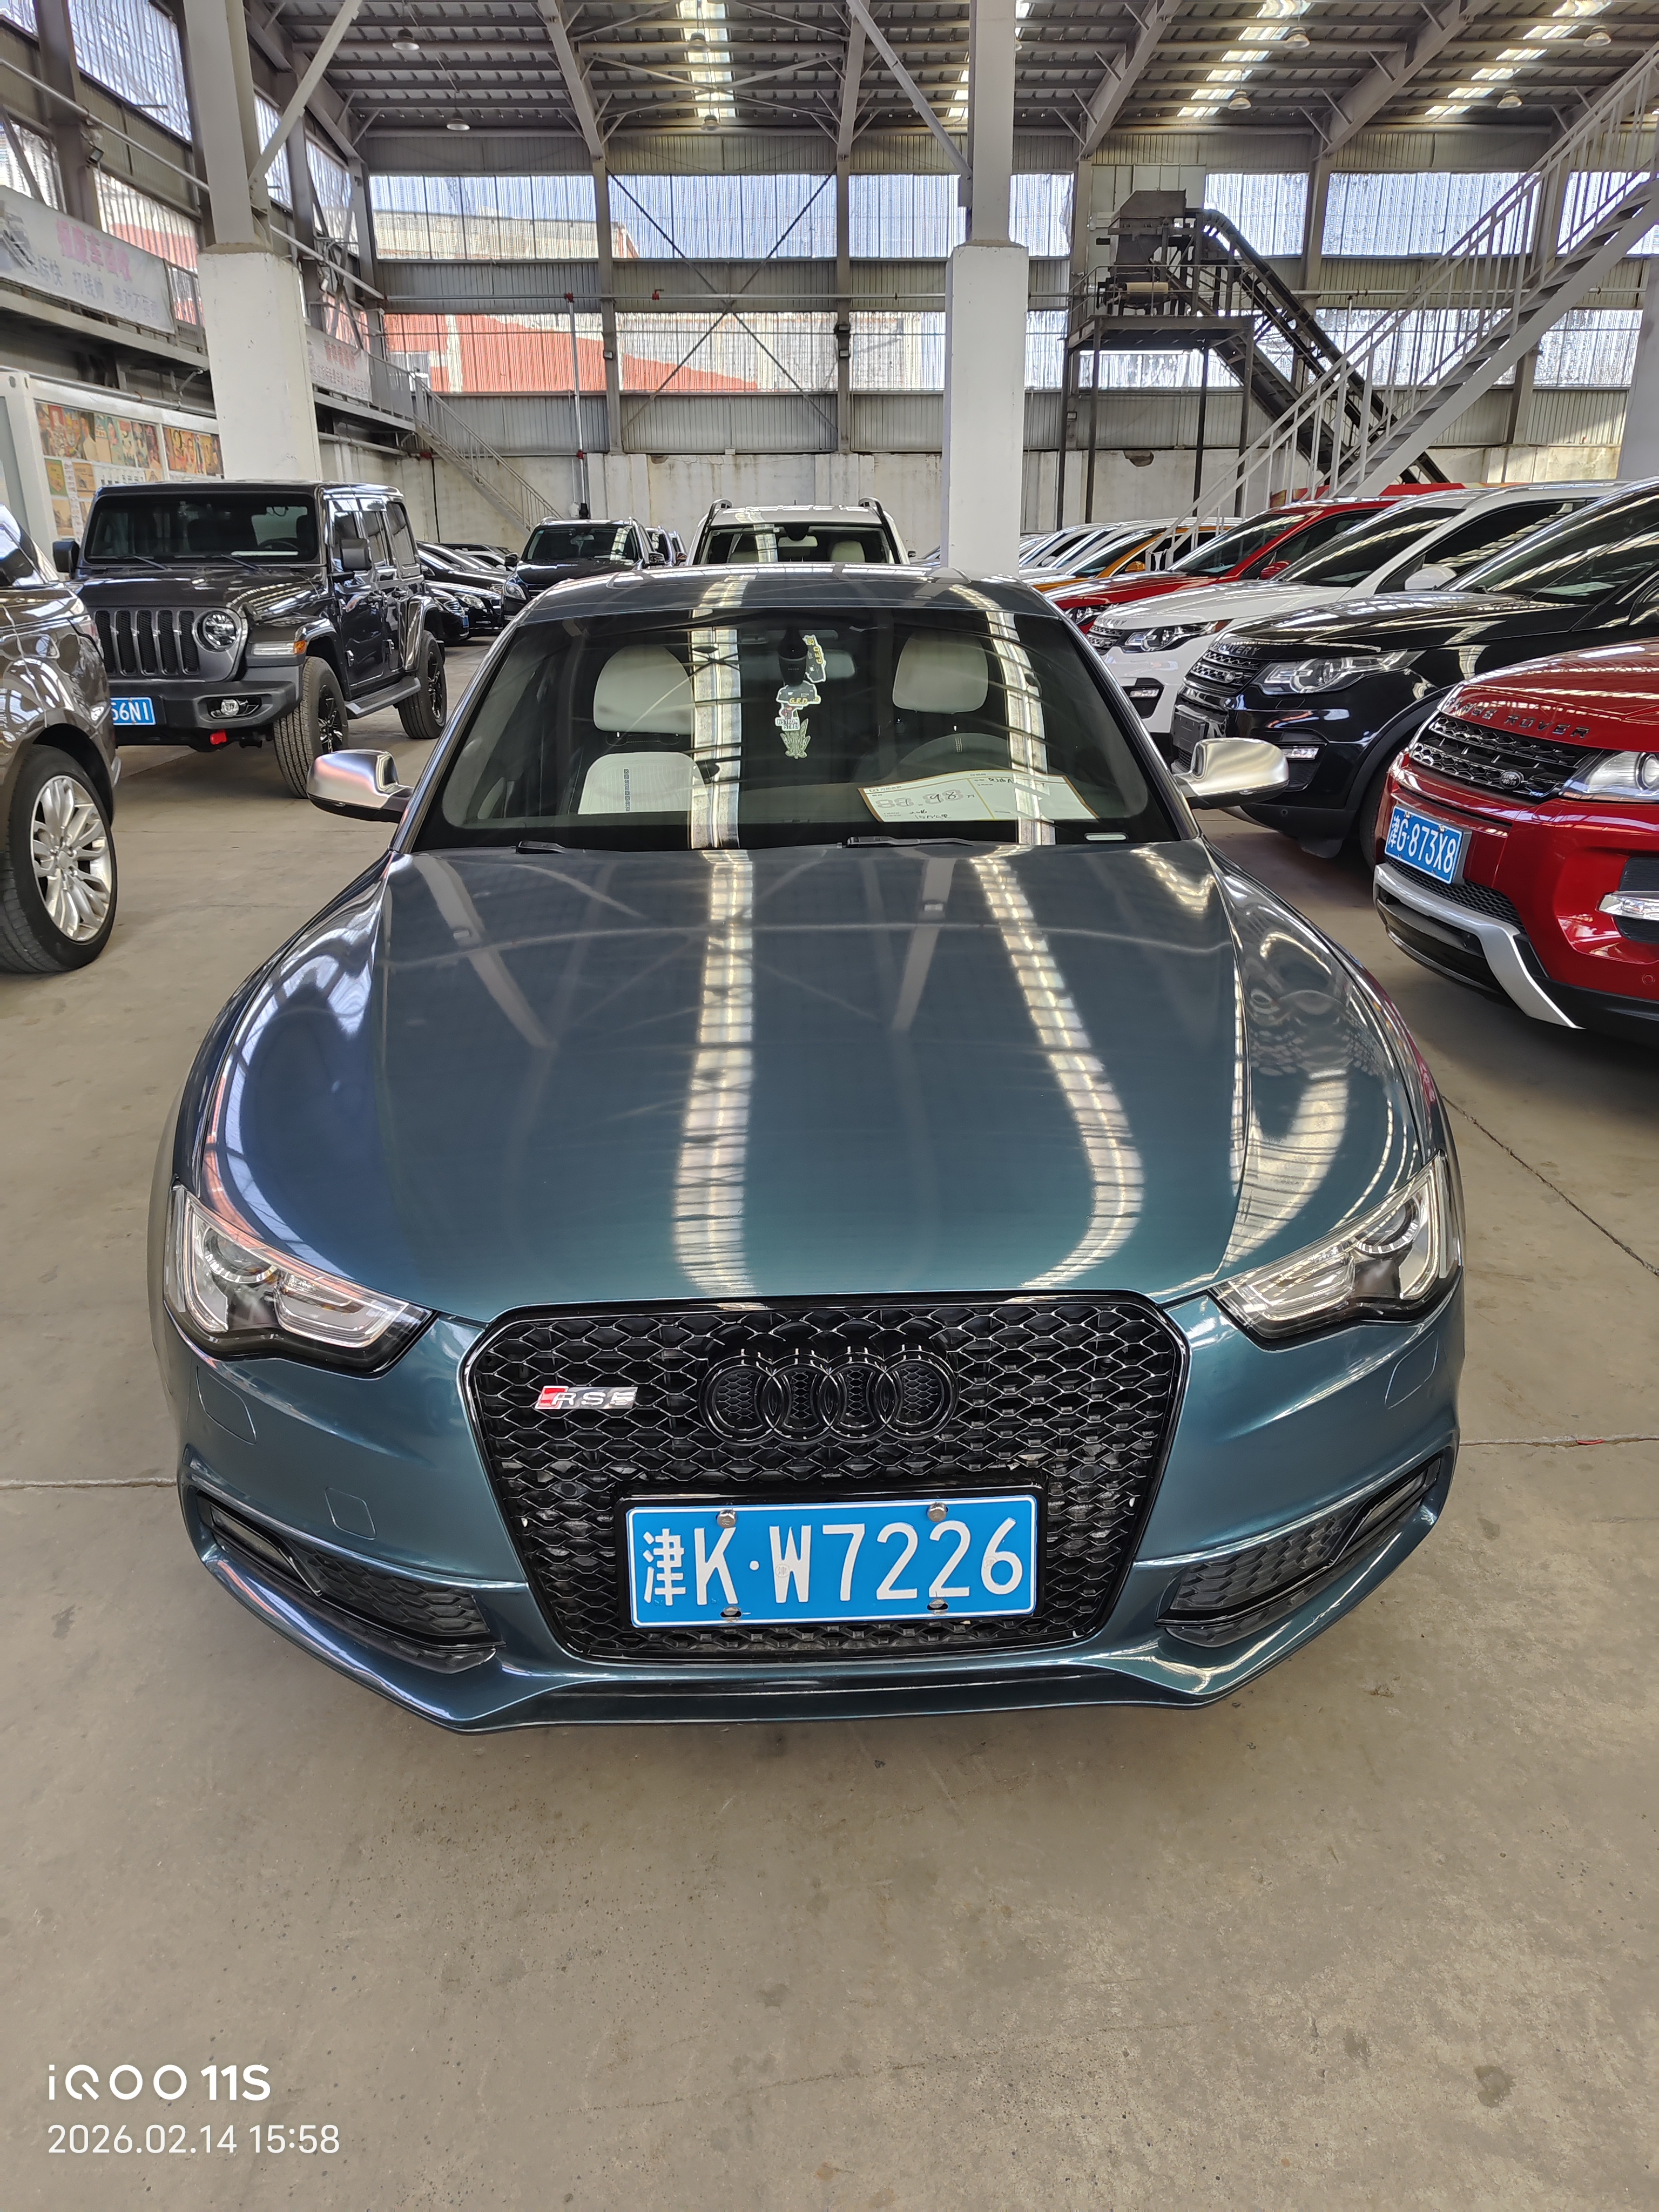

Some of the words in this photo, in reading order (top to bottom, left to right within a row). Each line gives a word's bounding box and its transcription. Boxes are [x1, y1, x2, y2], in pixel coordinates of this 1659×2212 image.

[1504, 714, 1589, 739] ROVER
[1388, 815, 1456, 873] 津G·873X8
[642, 1518, 1023, 1606] 津K·W7226
